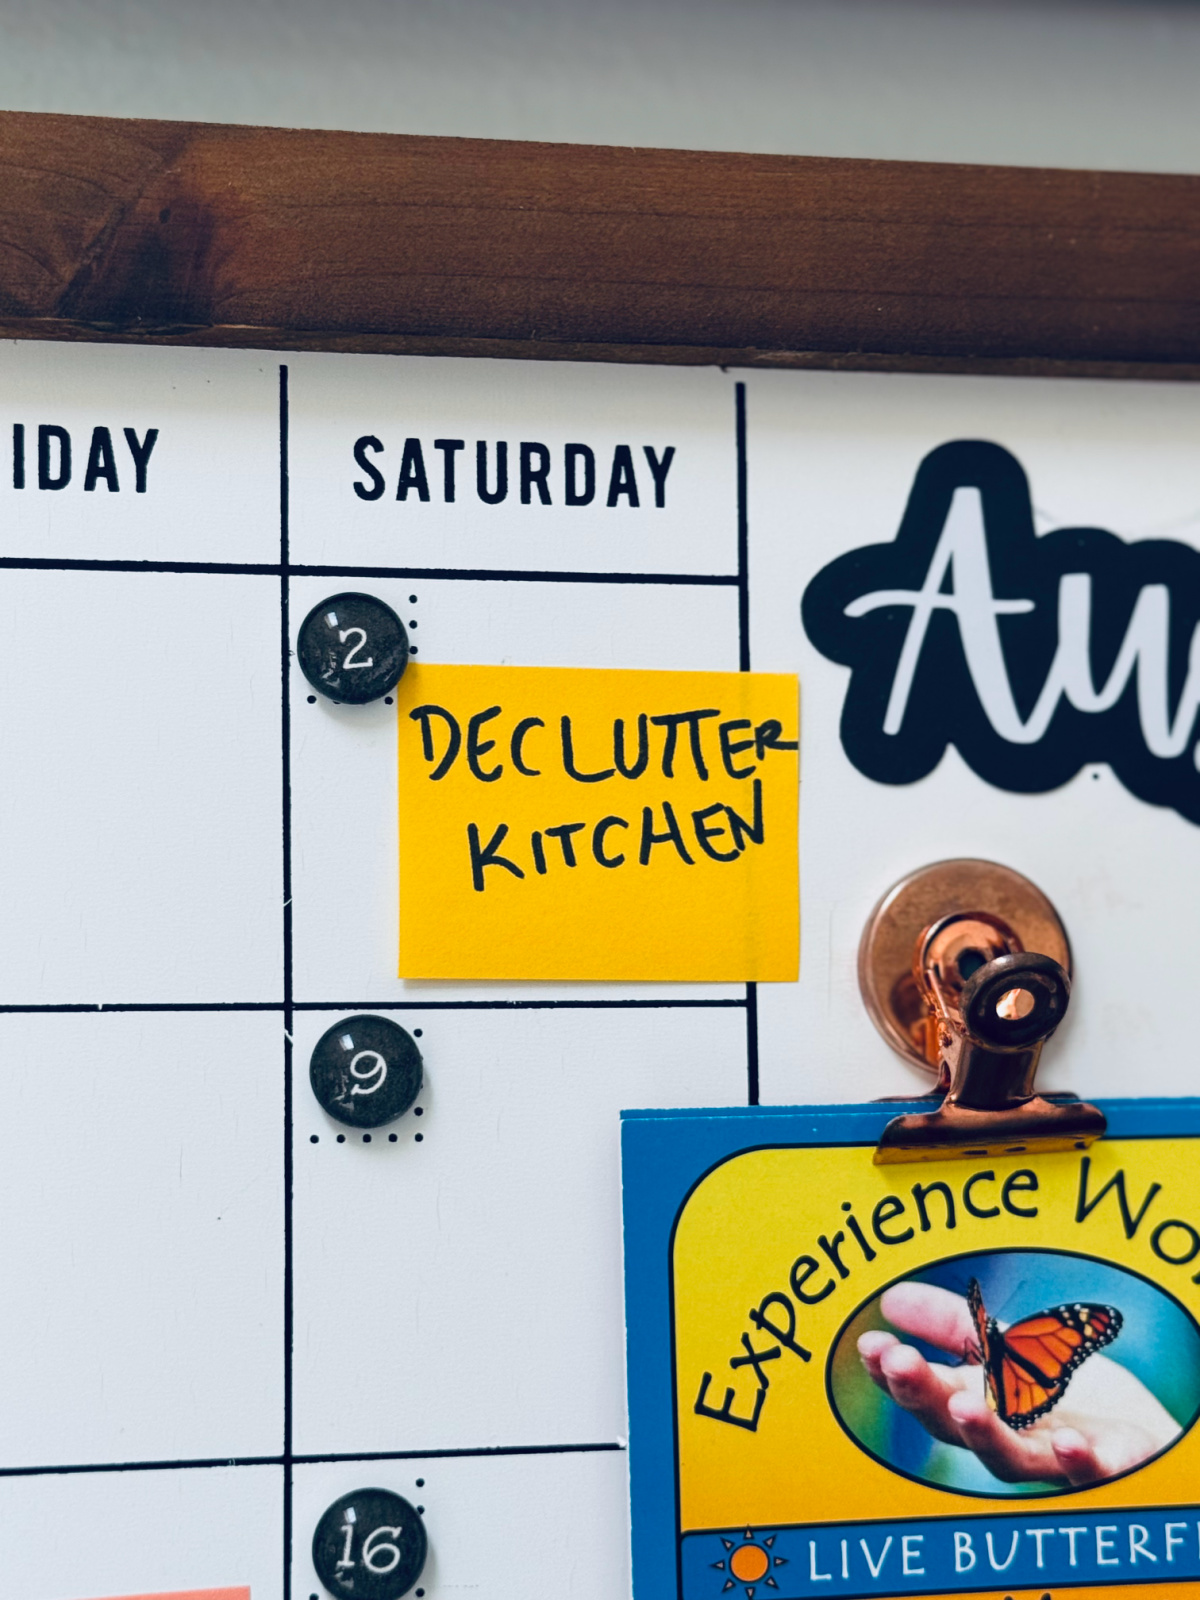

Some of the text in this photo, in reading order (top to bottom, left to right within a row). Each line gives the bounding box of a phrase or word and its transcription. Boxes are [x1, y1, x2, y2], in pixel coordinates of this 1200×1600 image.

[353, 434, 676, 509] SATURDAY
[339, 627, 373, 670] 2
[843, 486, 1200, 771] Au
[408, 704, 799, 783] DECLUTTER
[467, 779, 765, 892] KITCHEN
[349, 1050, 388, 1096] 9
[693, 1155, 1200, 1433] Experience Wo
[336, 1524, 402, 1574] 16
[808, 1521, 1200, 1582] LIVE BUTTERF
